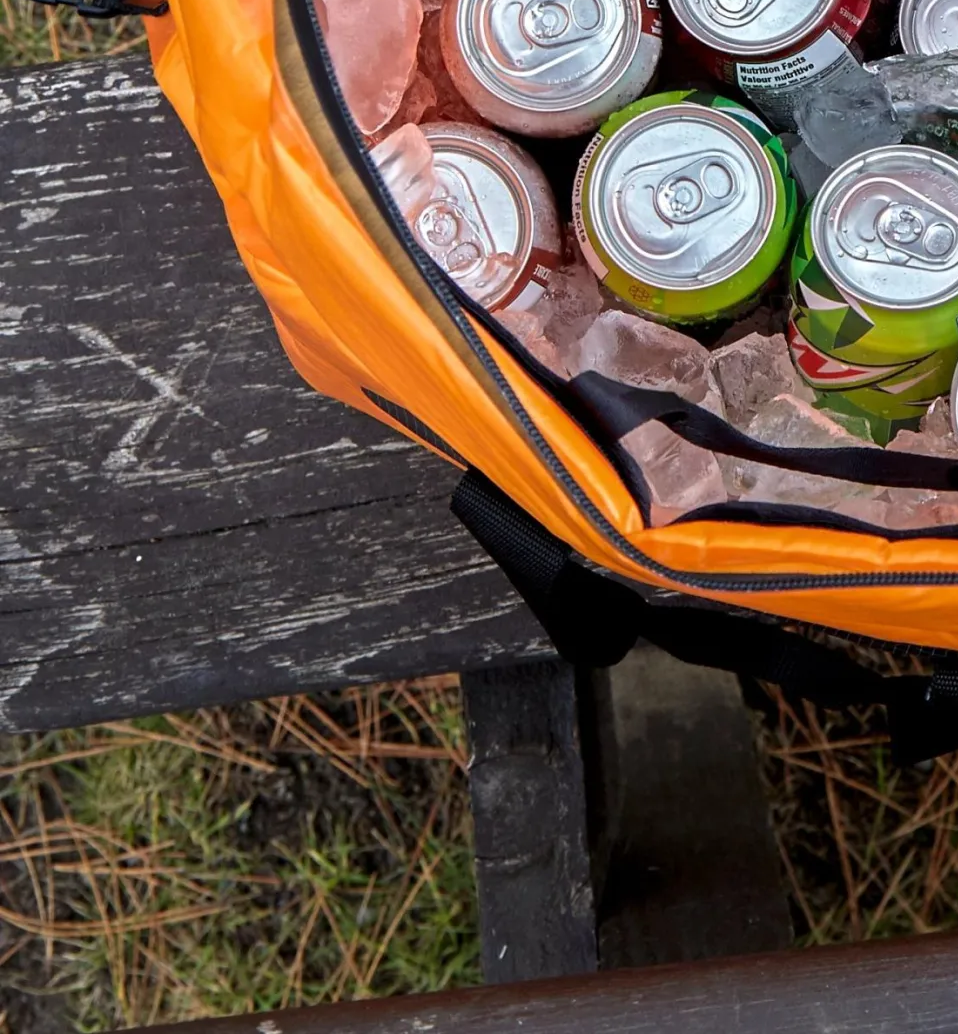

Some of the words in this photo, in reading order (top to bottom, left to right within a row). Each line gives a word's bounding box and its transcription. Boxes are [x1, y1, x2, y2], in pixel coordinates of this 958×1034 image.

[740, 63, 780, 75] Nutrition
[782, 56, 806, 70] Facts
[775, 63, 814, 82] nutritive
[574, 137, 602, 197] Nutrition
[574, 202, 586, 243] Facts
